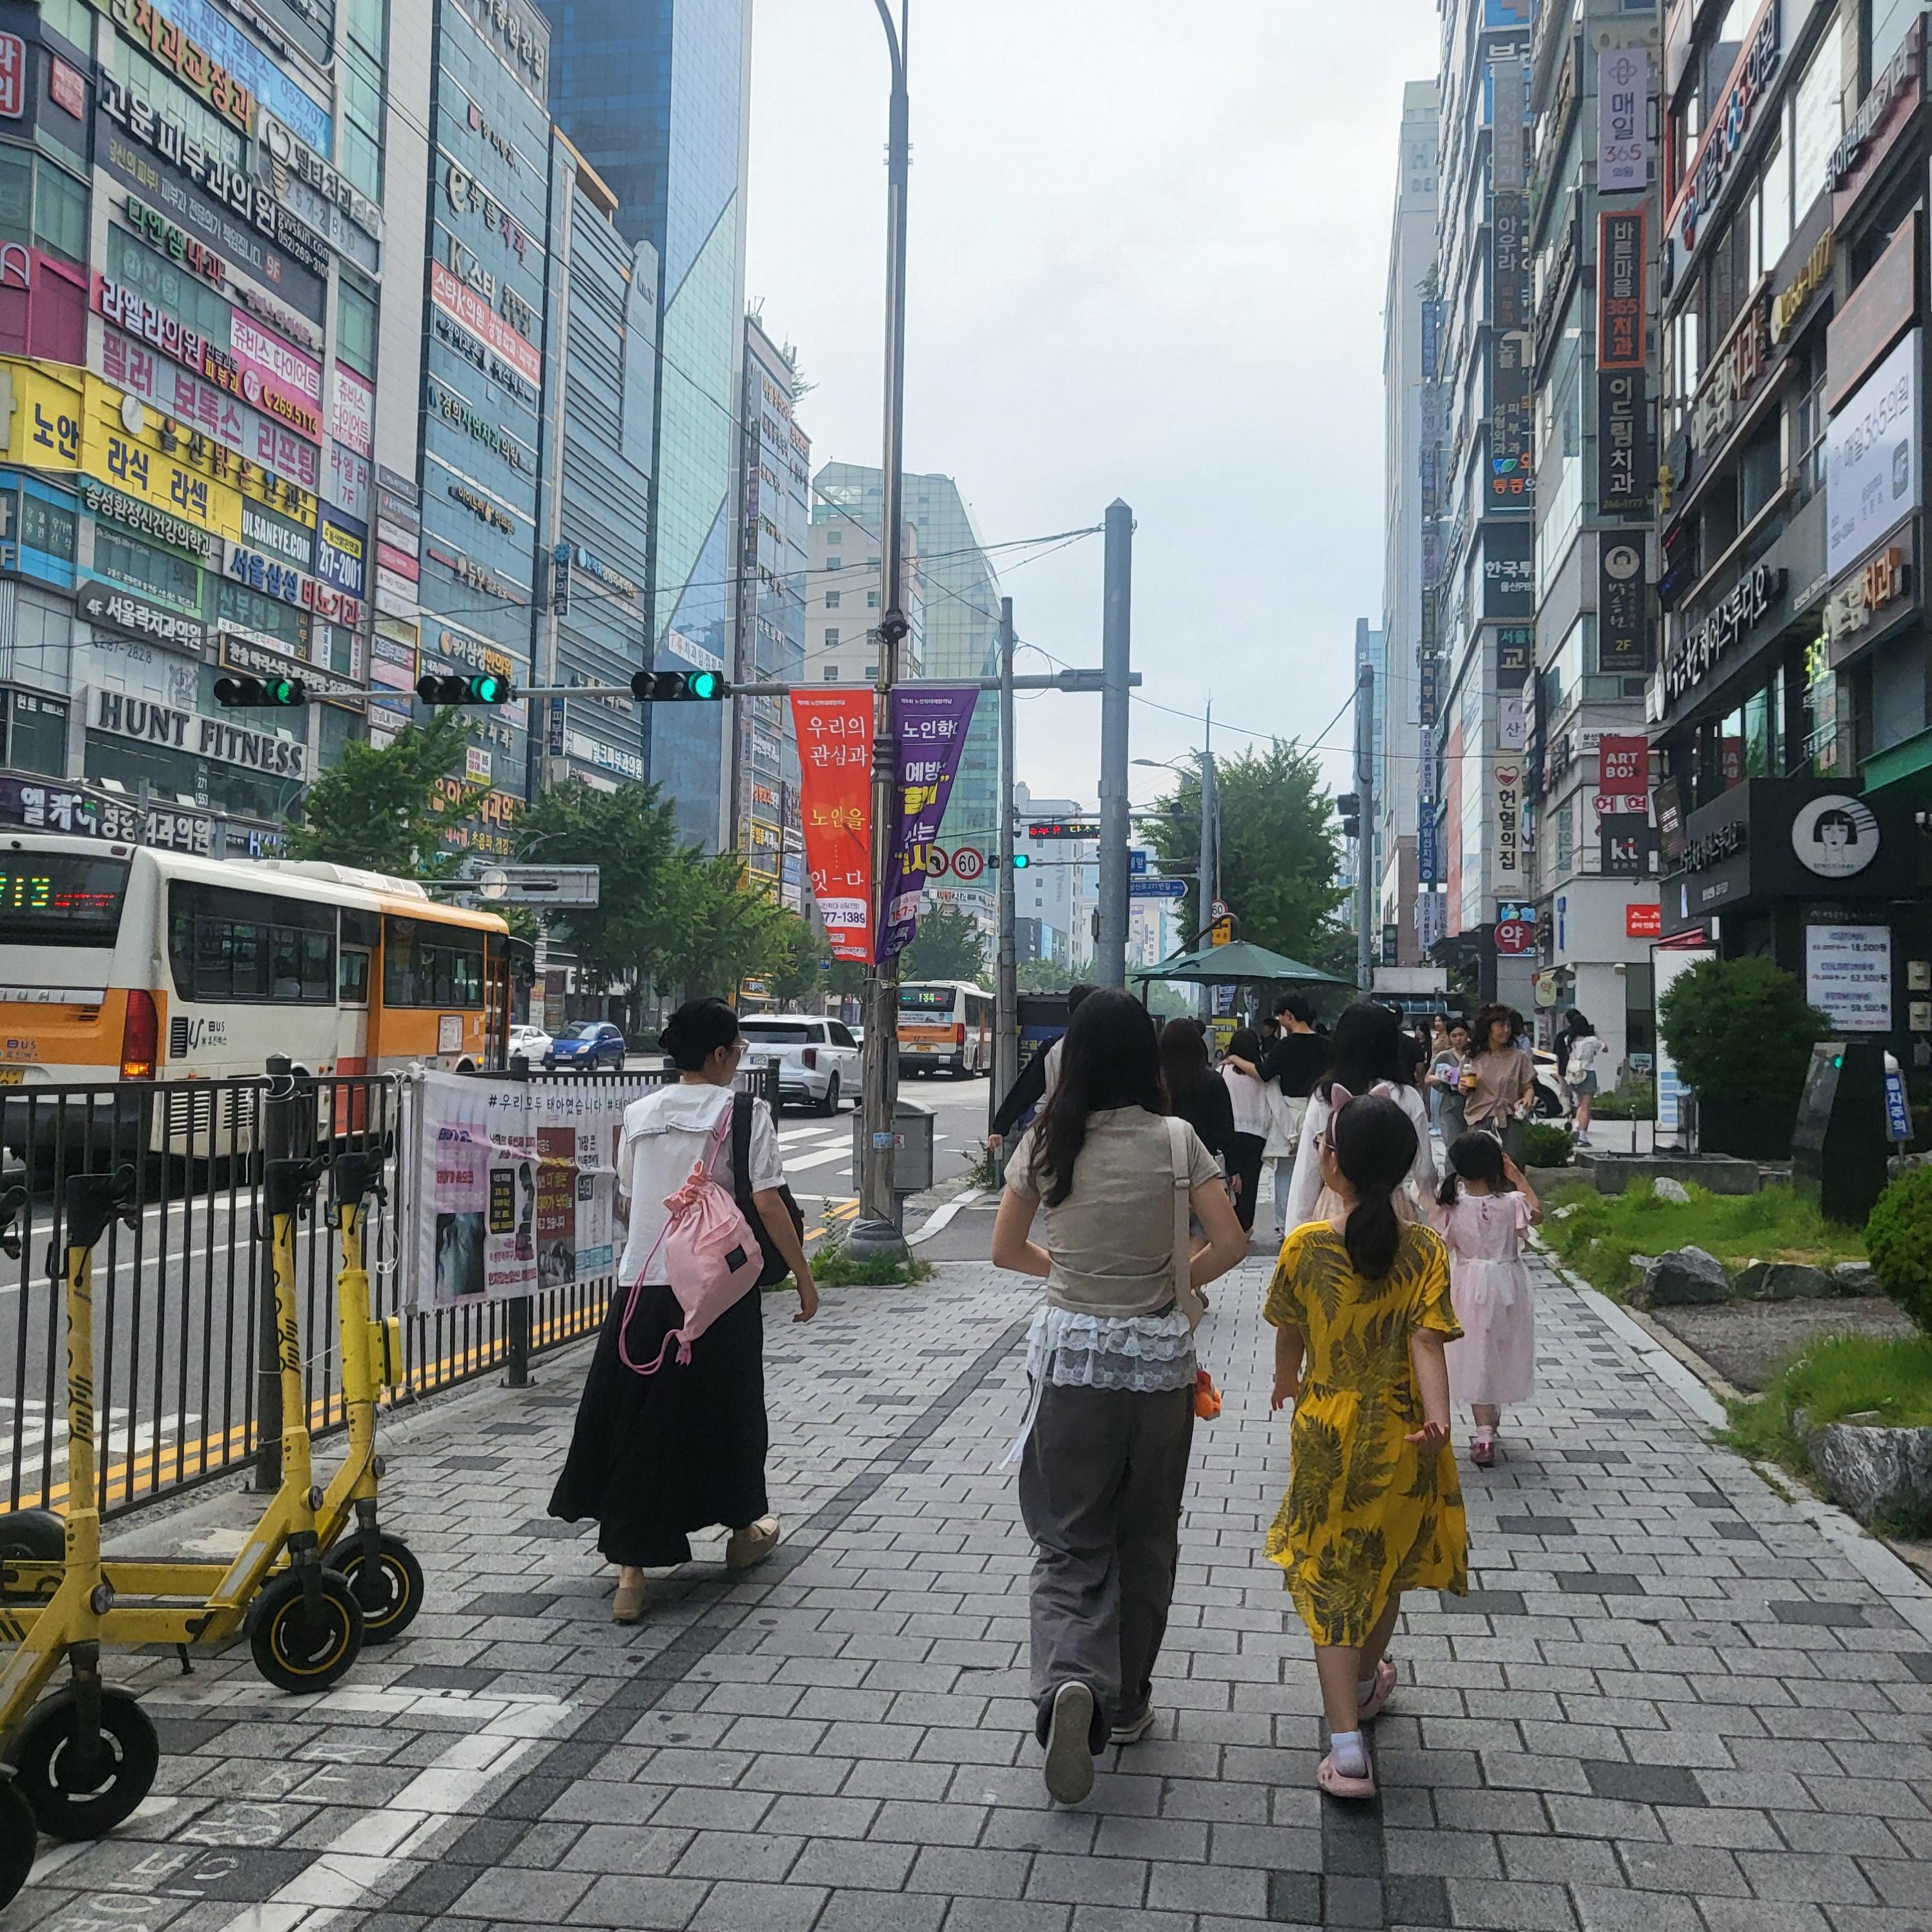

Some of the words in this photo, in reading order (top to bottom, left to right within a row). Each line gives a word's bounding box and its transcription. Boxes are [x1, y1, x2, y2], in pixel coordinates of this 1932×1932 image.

[1612, 92, 1635, 141] 매일
[101, 67, 275, 239] 고운피부과의원
[1603, 143, 1643, 163] 365
[161, 177, 187, 214] 피부과
[189, 196, 221, 240] 전문의가
[277, 210, 330, 265] gwskin.com
[1497, 215, 1518, 273] 아우라
[266, 252, 282, 279] 9F
[101, 276, 201, 371] 라엘라의원
[1606, 298, 1638, 315] 365
[1613, 316, 1634, 356] 치과
[205, 358, 239, 394] 피부과
[233, 323, 270, 365] 쥬비스
[273, 344, 320, 399] 다이어트
[103, 330, 154, 398] 필러
[173, 372, 242, 445] 보톡스
[258, 422, 315, 486] 리프팅
[338, 379, 366, 413] 쥬비스
[33, 402, 79, 461] 노안
[333, 402, 369, 441] 다이어트
[1493, 403, 1506, 455] 성형외과
[1508, 403, 1521, 455] 피부과
[1610, 376, 1635, 495] 이드림치과
[107, 437, 149, 491] 라식
[170, 468, 209, 519] 라섹
[331, 449, 367, 490] 라엘라
[341, 485, 355, 505] 7F
[242, 509, 311, 565] ULSANEYE.COM
[230, 548, 298, 605] 서울삼성
[302, 579, 361, 626] 비뇨기과
[86, 597, 103, 616] 4F
[1615, 639, 1632, 652] 2F
[98, 690, 190, 746] HUNT
[199, 719, 303, 776] FITNESS
[806, 716, 866, 740] 우리의
[810, 744, 868, 768] 관심과
[905, 761, 947, 783] 예방
[1605, 766, 1634, 778] BOX
[1606, 752, 1639, 765] ART
[195, 792, 209, 807] 1553
[197, 776, 208, 790] 271
[809, 807, 866, 832] 노인을
[1498, 789, 1516, 870] 헌혈의집
[959, 854, 976, 872] 60
[1212, 905, 1223, 917] 60
[1500, 925, 1525, 949] 약
[6, 1039, 37, 1049] BUS
[208, 1020, 226, 1033] BUS
[546, 1098, 602, 1116] 태아였습니다
